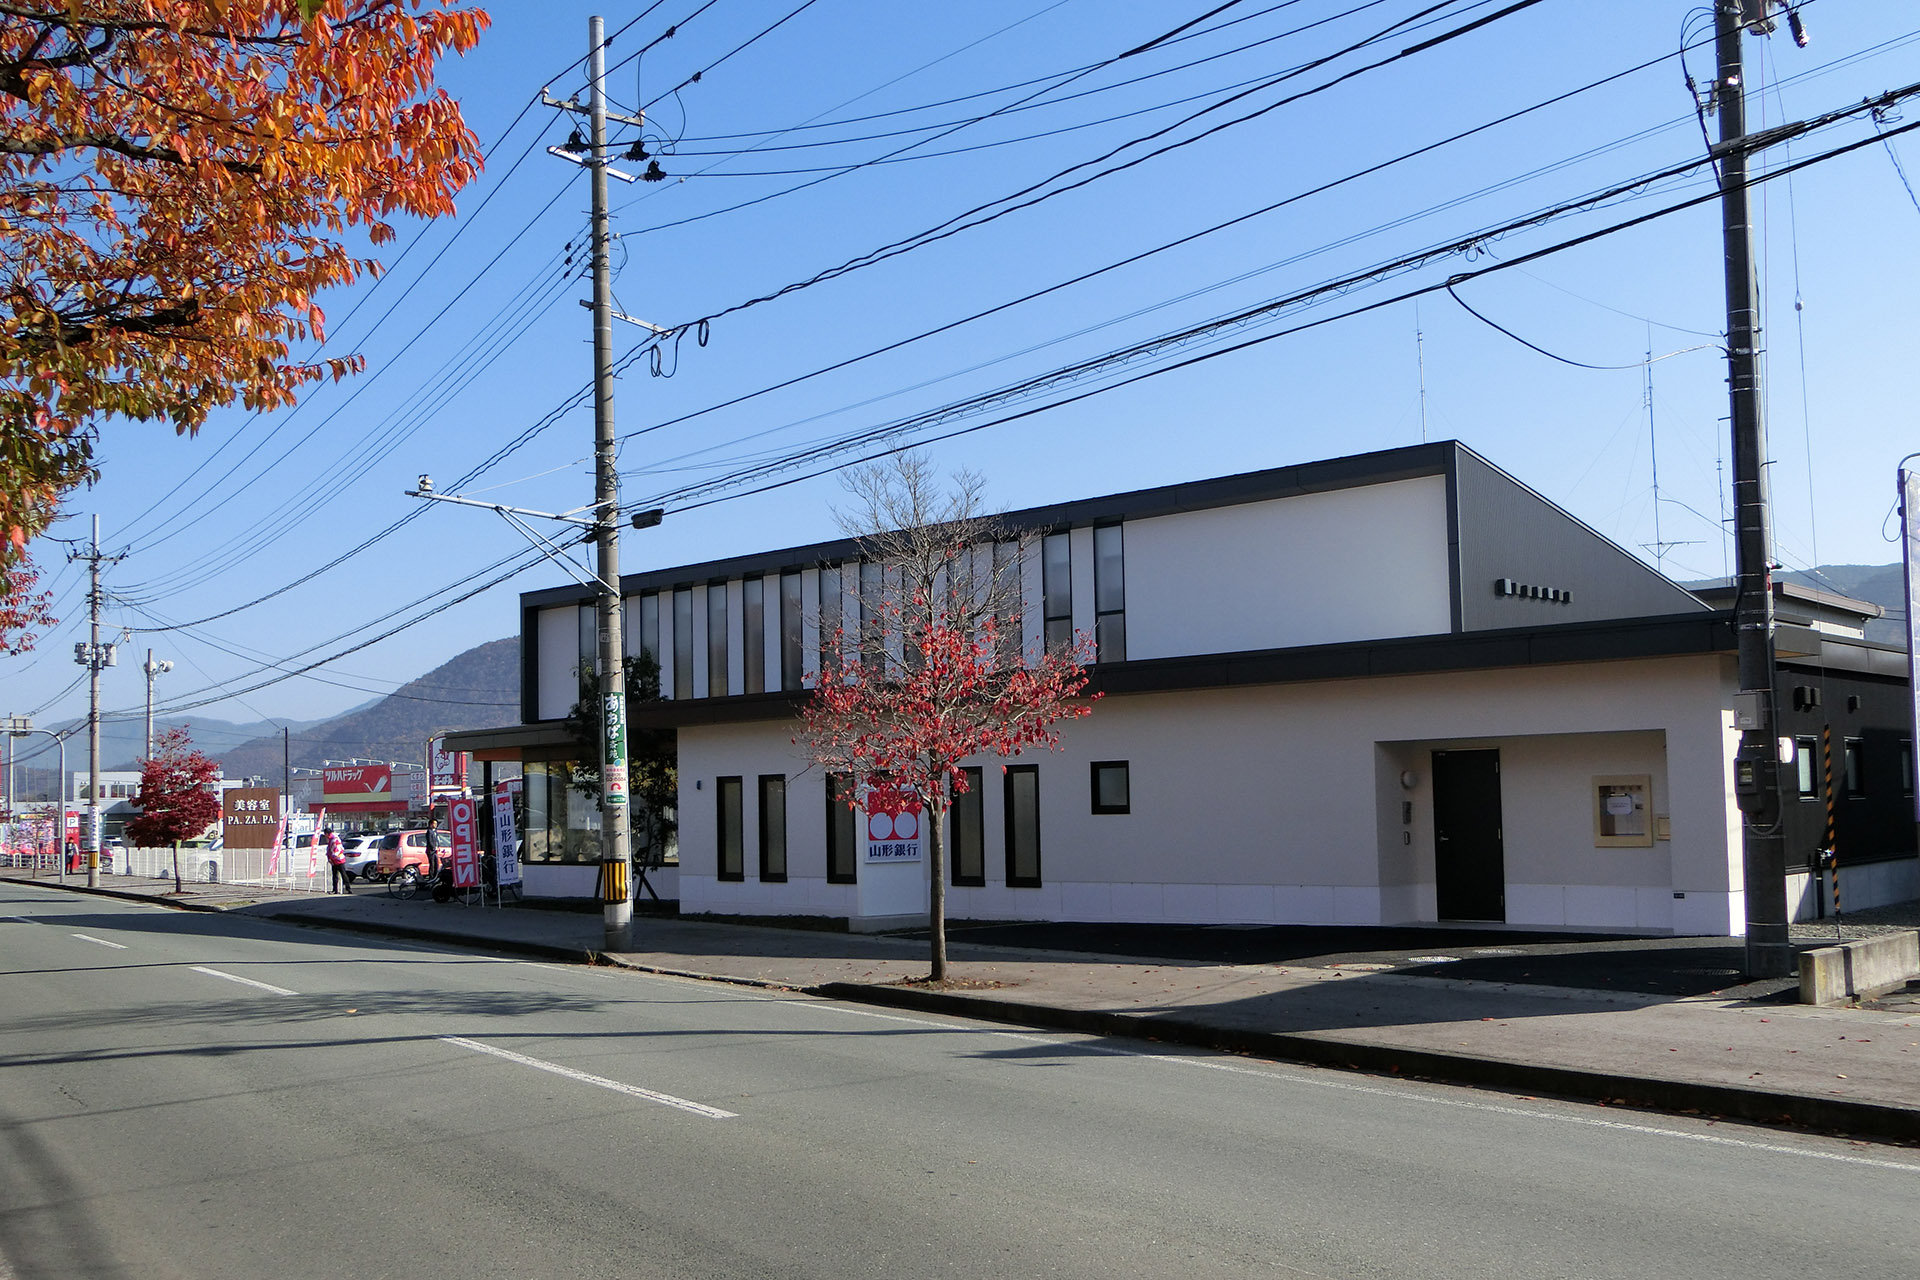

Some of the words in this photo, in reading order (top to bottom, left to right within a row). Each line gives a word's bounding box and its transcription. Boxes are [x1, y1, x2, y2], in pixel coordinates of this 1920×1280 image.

[325, 769, 364, 781] ツルハドラッグ
[234, 799, 270, 811] 美容室
[500, 814, 515, 874] 山形銀行
[869, 843, 918, 857] 山形銀行
